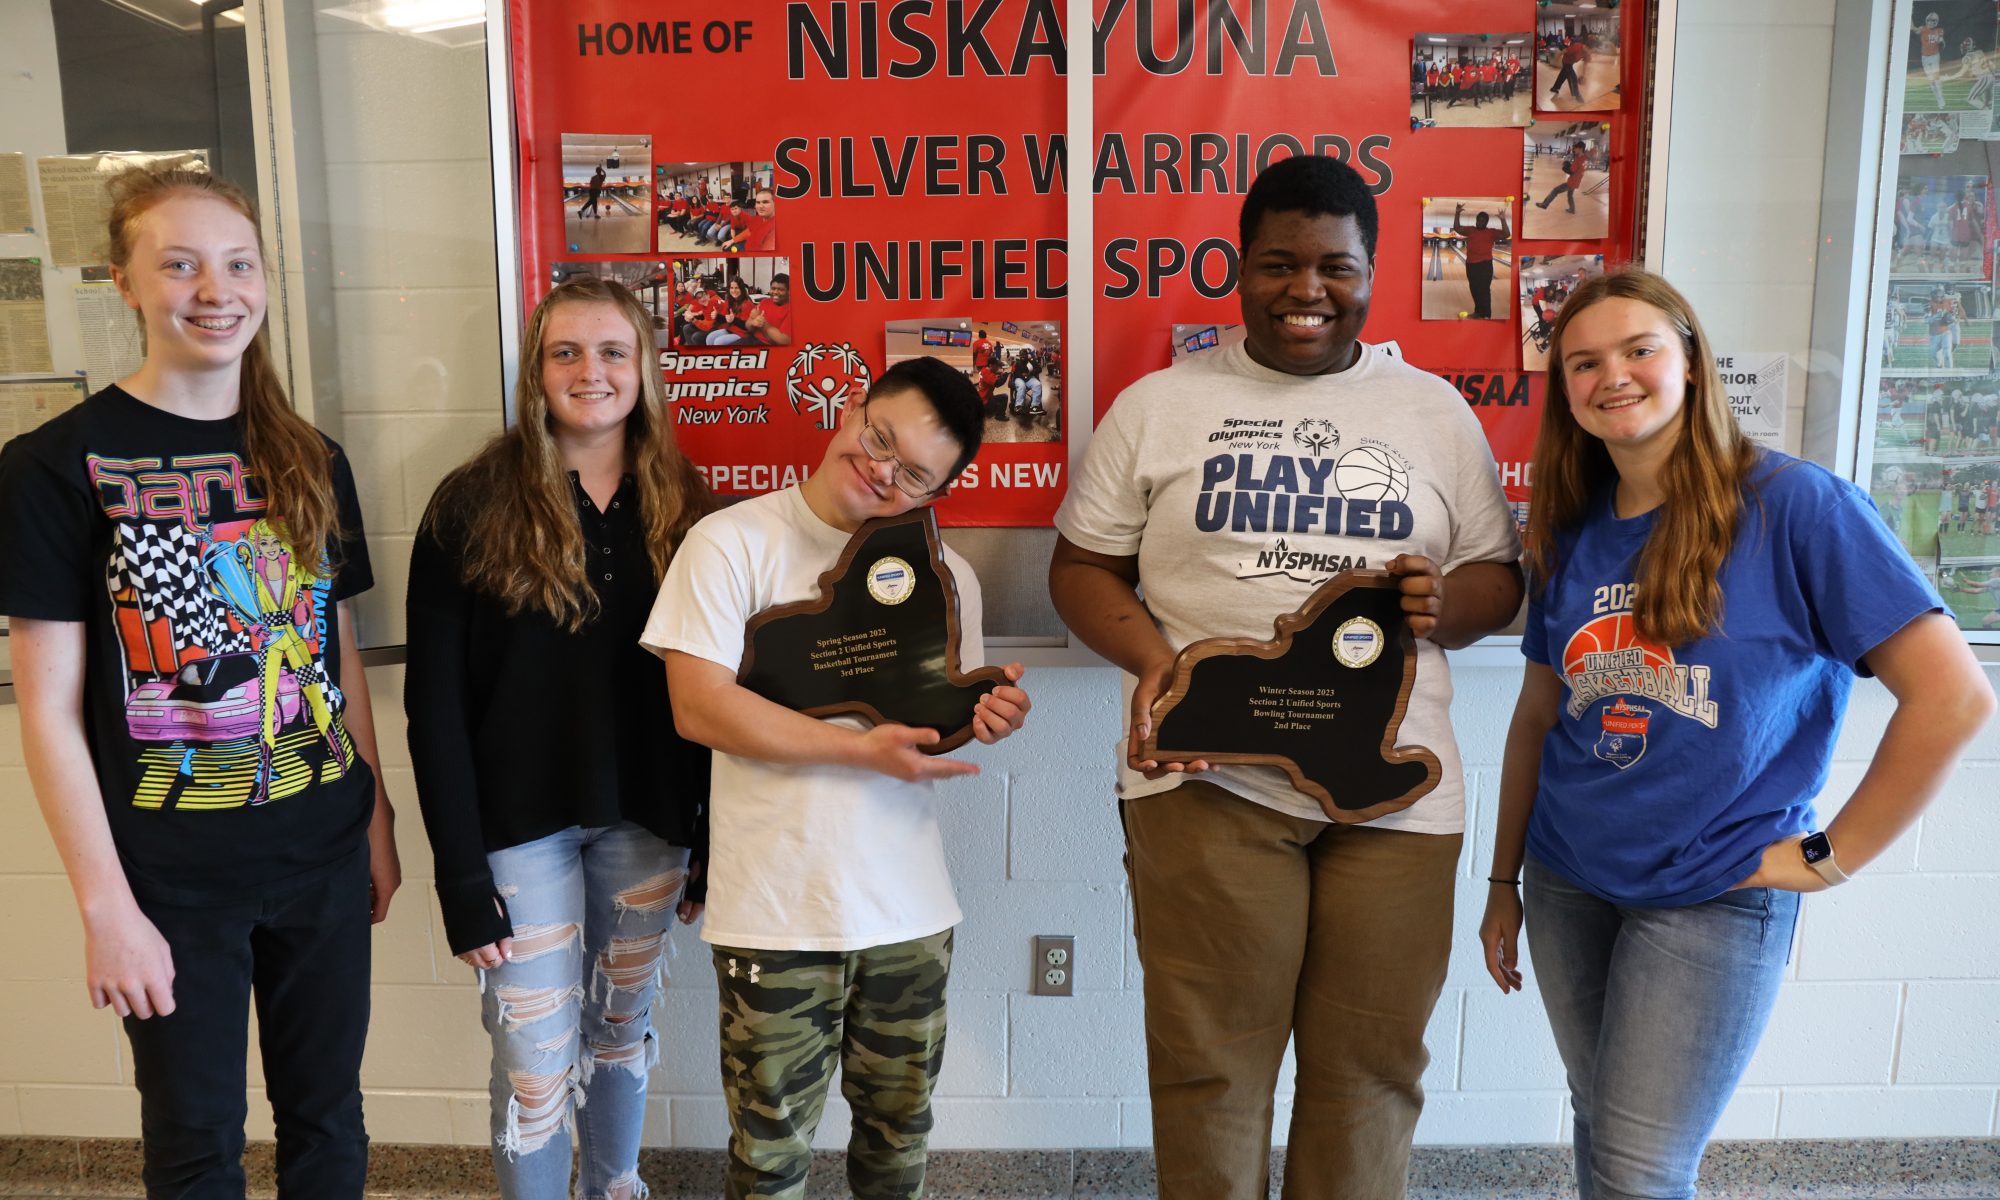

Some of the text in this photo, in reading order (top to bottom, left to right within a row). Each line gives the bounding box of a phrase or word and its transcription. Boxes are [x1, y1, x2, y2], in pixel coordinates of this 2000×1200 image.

[578, 20, 753, 56] HOME OF
[775, 133, 1008, 200] SILVER
[801, 237, 1240, 302] UNIFIED SPO
[658, 350, 768, 375] Special
[1716, 357, 1733, 368] HE
[1720, 373, 1757, 384] RIOR
[664, 378, 769, 402] ympics
[677, 405, 767, 425] New York
[1731, 406, 1761, 415] THLY
[1223, 418, 1283, 428] Special
[1208, 430, 1283, 442] Olympics
[1229, 441, 1280, 449] New York
[696, 464, 809, 490] SPECIAL
[991, 463, 1061, 488] NEW
[1201, 453, 1335, 495] PLAY
[1195, 491, 1414, 540] UNIFIED
[1256, 551, 1367, 573] NYSPHSAA
[1593, 583, 1640, 614] 202
[817, 628, 887, 648] Spring Season 2023
[810, 650, 837, 660] Section
[844, 643, 872, 654] Unified
[872, 639, 897, 649] Sports
[813, 650, 898, 671] Basketball Tournament
[1585, 649, 1643, 671] UNIFIED
[840, 666, 875, 677] 3rd Place
[1259, 686, 1335, 697] Winter Season 2023
[1248, 697, 1341, 709] Section 2 Unified Sports
[1253, 709, 1335, 720] Bowling Tournament
[1273, 721, 1289, 729] 2nd
